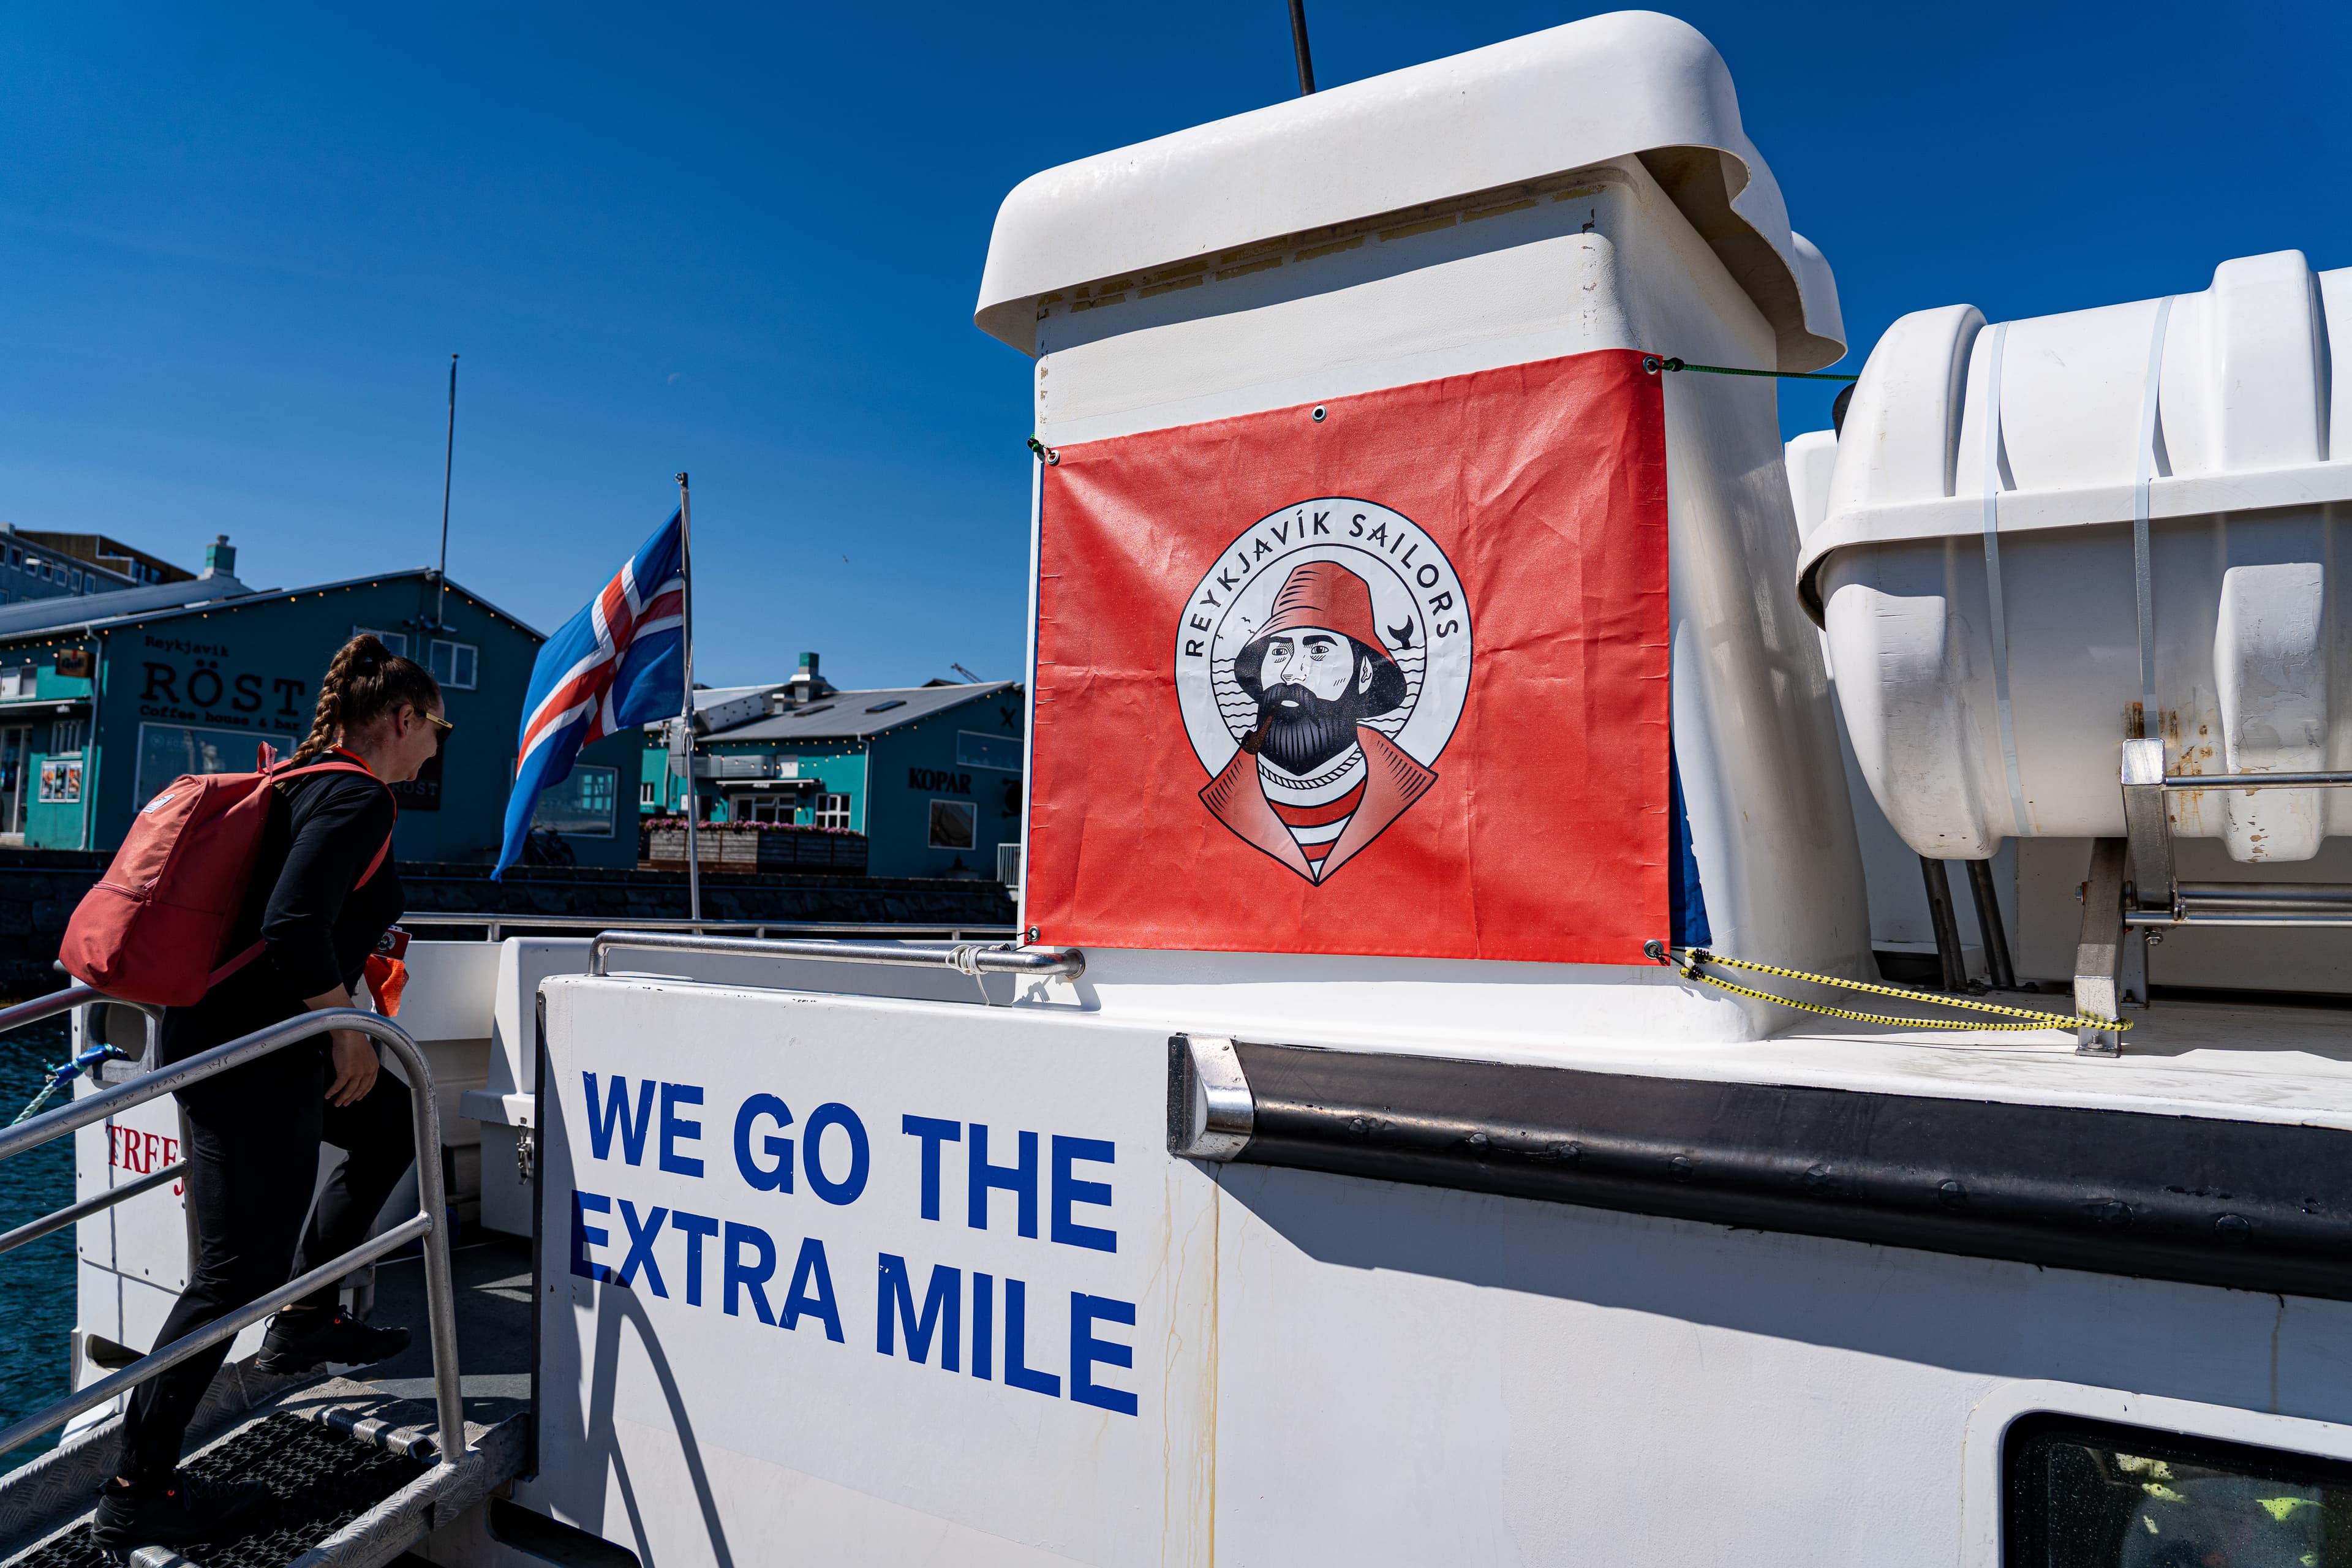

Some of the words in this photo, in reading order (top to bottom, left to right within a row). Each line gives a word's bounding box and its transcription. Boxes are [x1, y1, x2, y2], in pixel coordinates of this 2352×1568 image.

[1185, 509, 1332, 657] REYKJAVÍK
[1349, 513, 1459, 639] SAILORS
[140, 659, 306, 716] RÖST
[140, 705, 197, 720] Coffee
[205, 712, 249, 726] house
[274, 718, 301, 731] bar
[908, 767, 971, 794] KOPAR
[582, 1071, 704, 1178] WE
[733, 1093, 870, 1205] GO
[902, 1114, 1117, 1253] THE
[570, 1189, 845, 1344] EXTRA
[876, 1252, 1138, 1417] MILE
